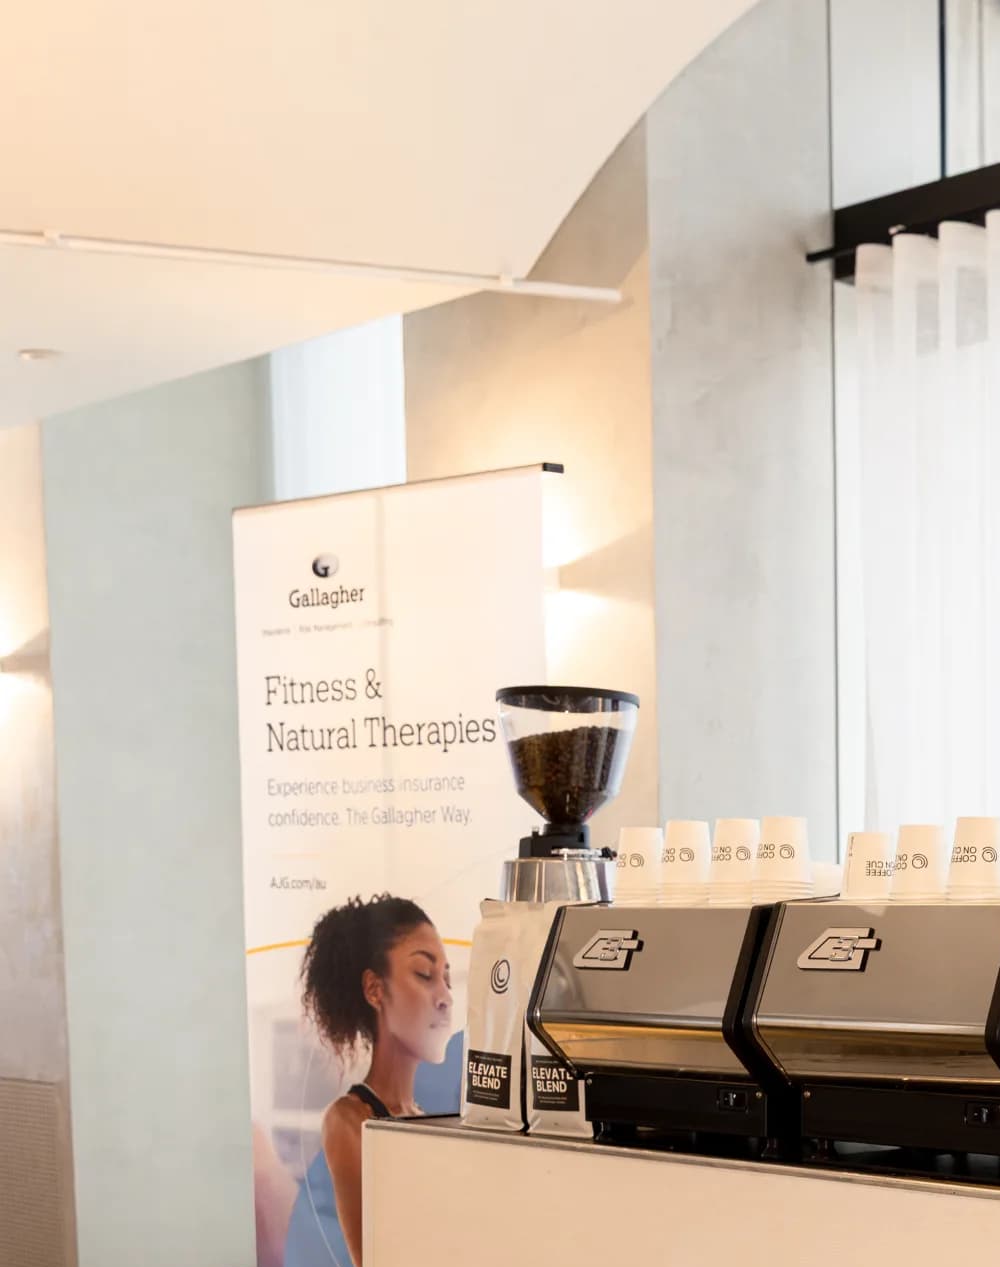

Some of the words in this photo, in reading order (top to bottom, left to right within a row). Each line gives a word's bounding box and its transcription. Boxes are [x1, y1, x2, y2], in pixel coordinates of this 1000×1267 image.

[289, 585, 365, 609] Gallagher
[265, 675, 357, 706] Fitness
[365, 669, 383, 700] &
[267, 719, 357, 753] Natural
[364, 713, 497, 753] Therapies
[267, 778, 338, 798] Experience
[342, 777, 395, 794] business
[346, 808, 369, 825] The
[371, 806, 436, 827] Gallagher
[963, 846, 977, 854] ON
[468, 1061, 508, 1079] ELEVATE
[472, 1075, 501, 1090] BLEND
[536, 1080, 567, 1093] BLEND
